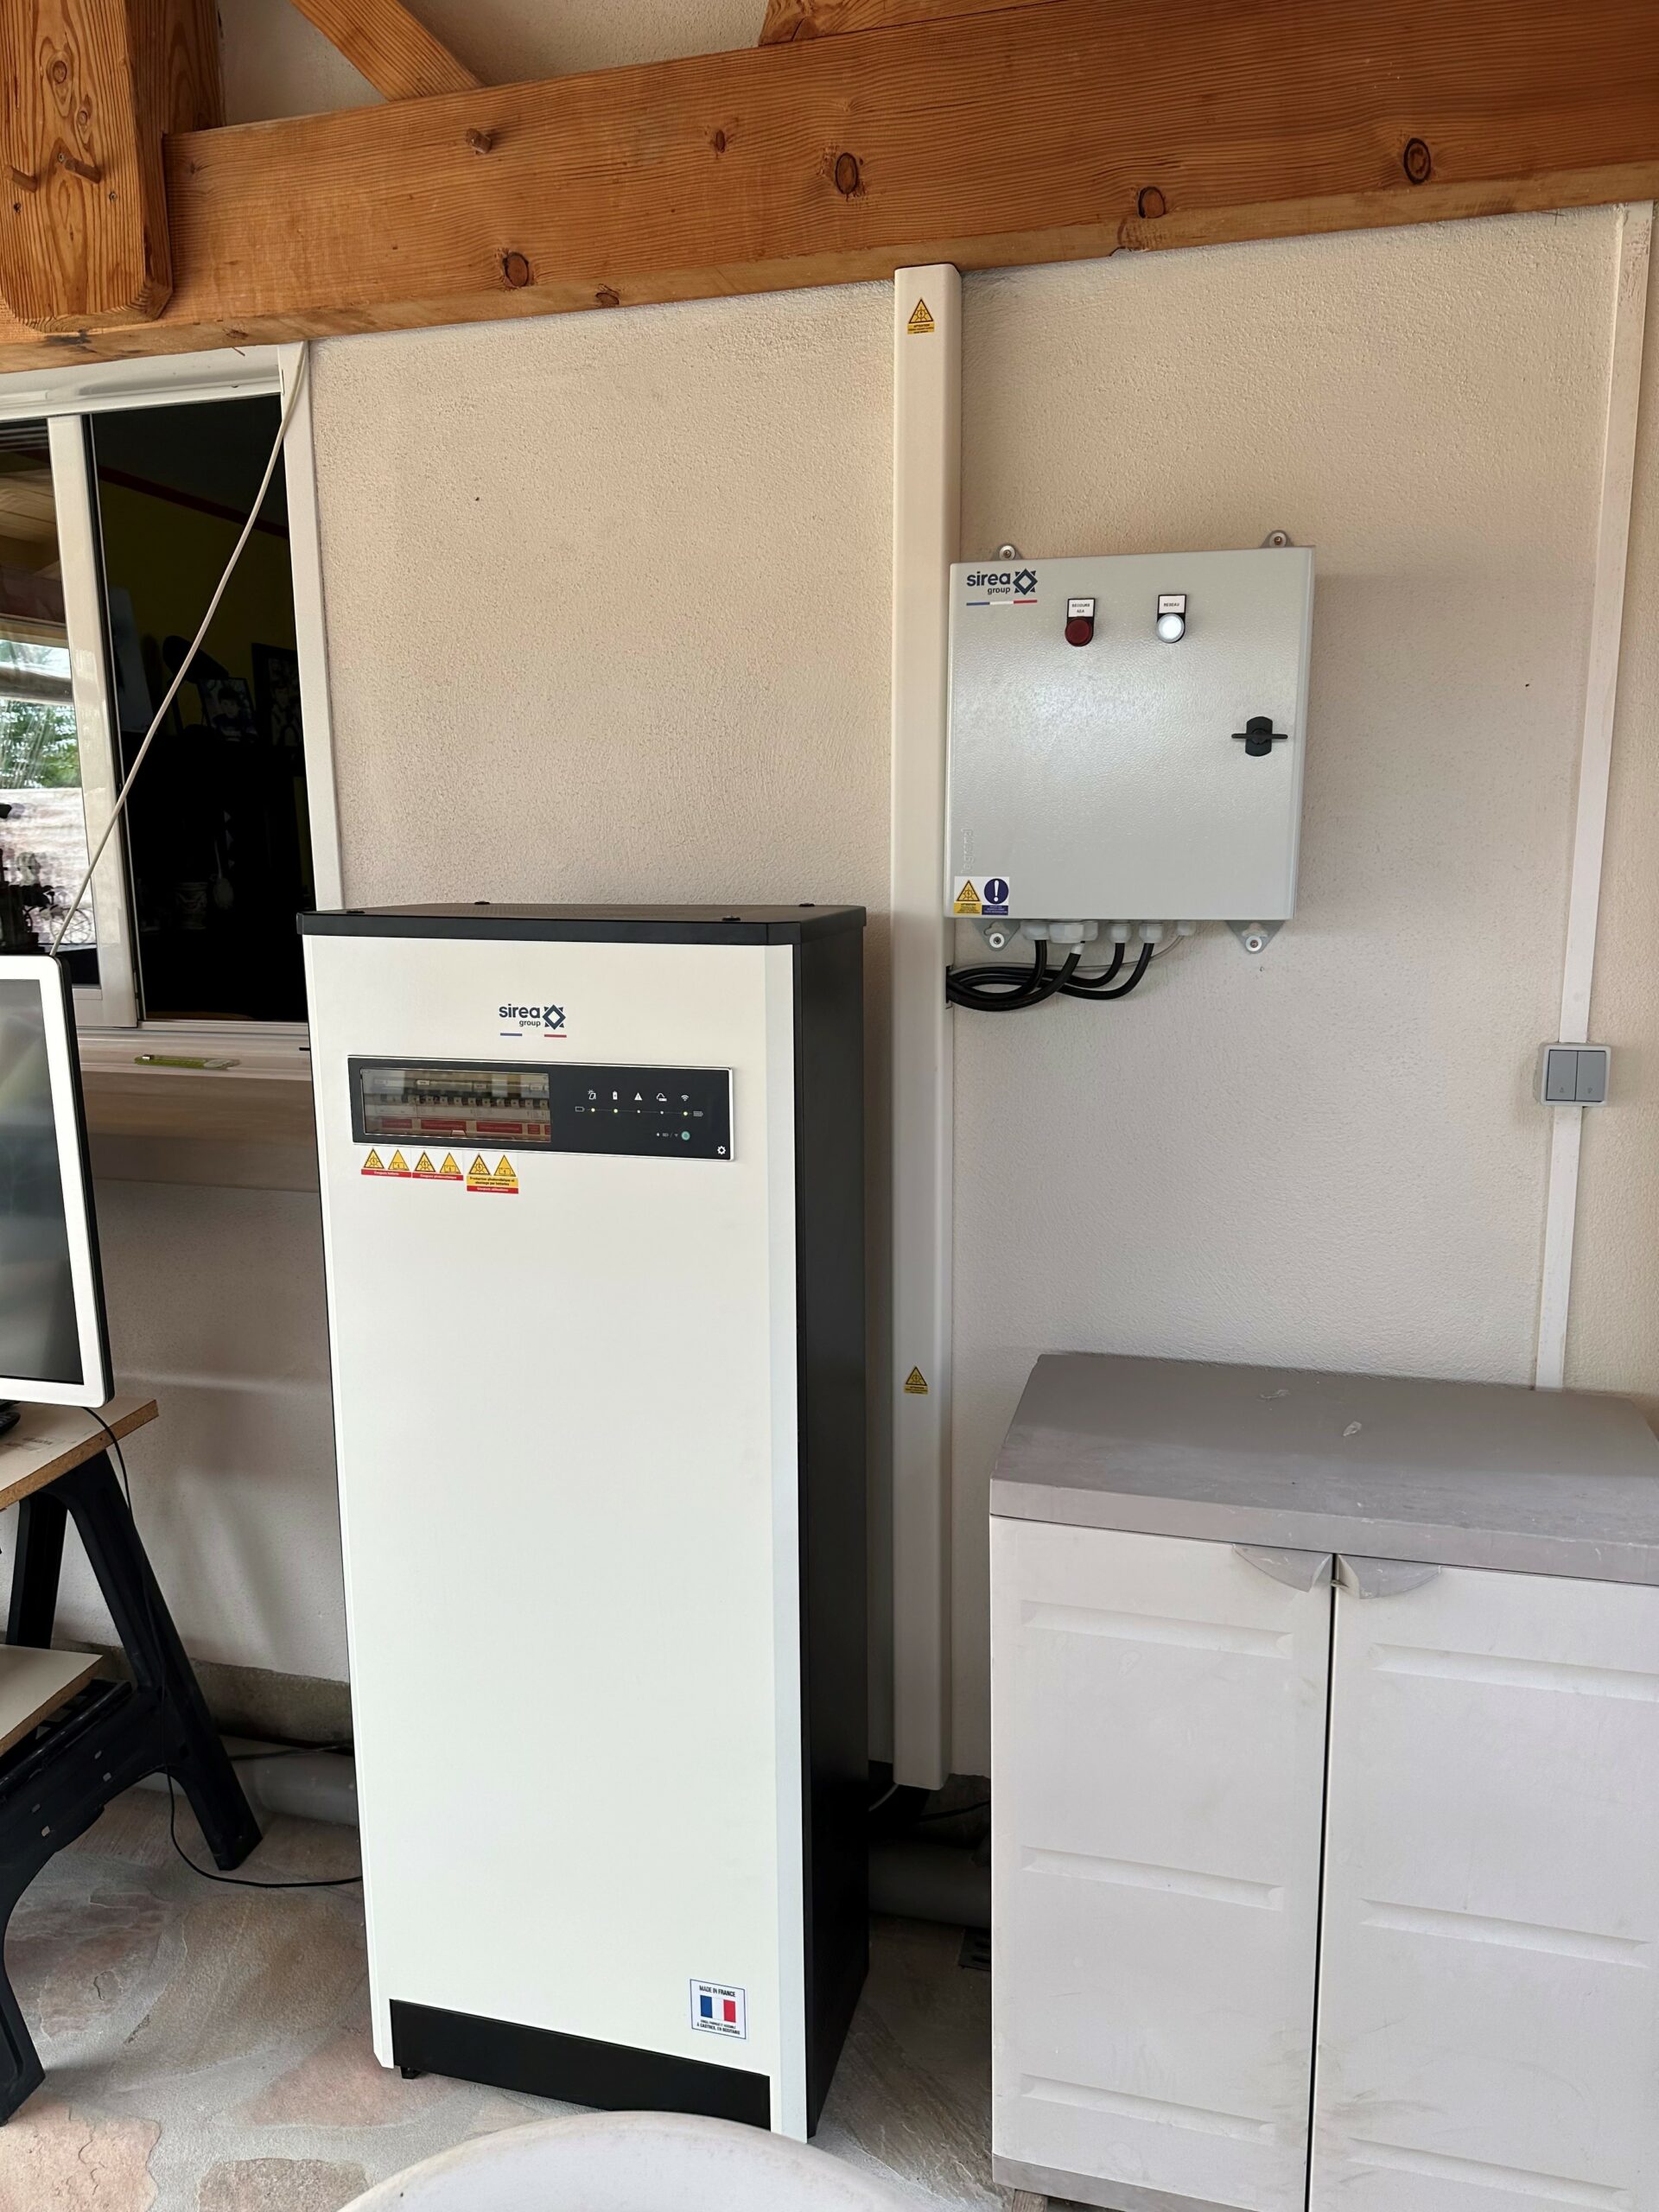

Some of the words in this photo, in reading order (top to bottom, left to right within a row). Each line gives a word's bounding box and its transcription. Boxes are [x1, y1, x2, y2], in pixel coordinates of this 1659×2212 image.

[966, 571, 1011, 587] sirea
[987, 587, 1011, 595] group
[499, 1003, 541, 1019] sirea
[718, 1988, 735, 1997] FRANCE
